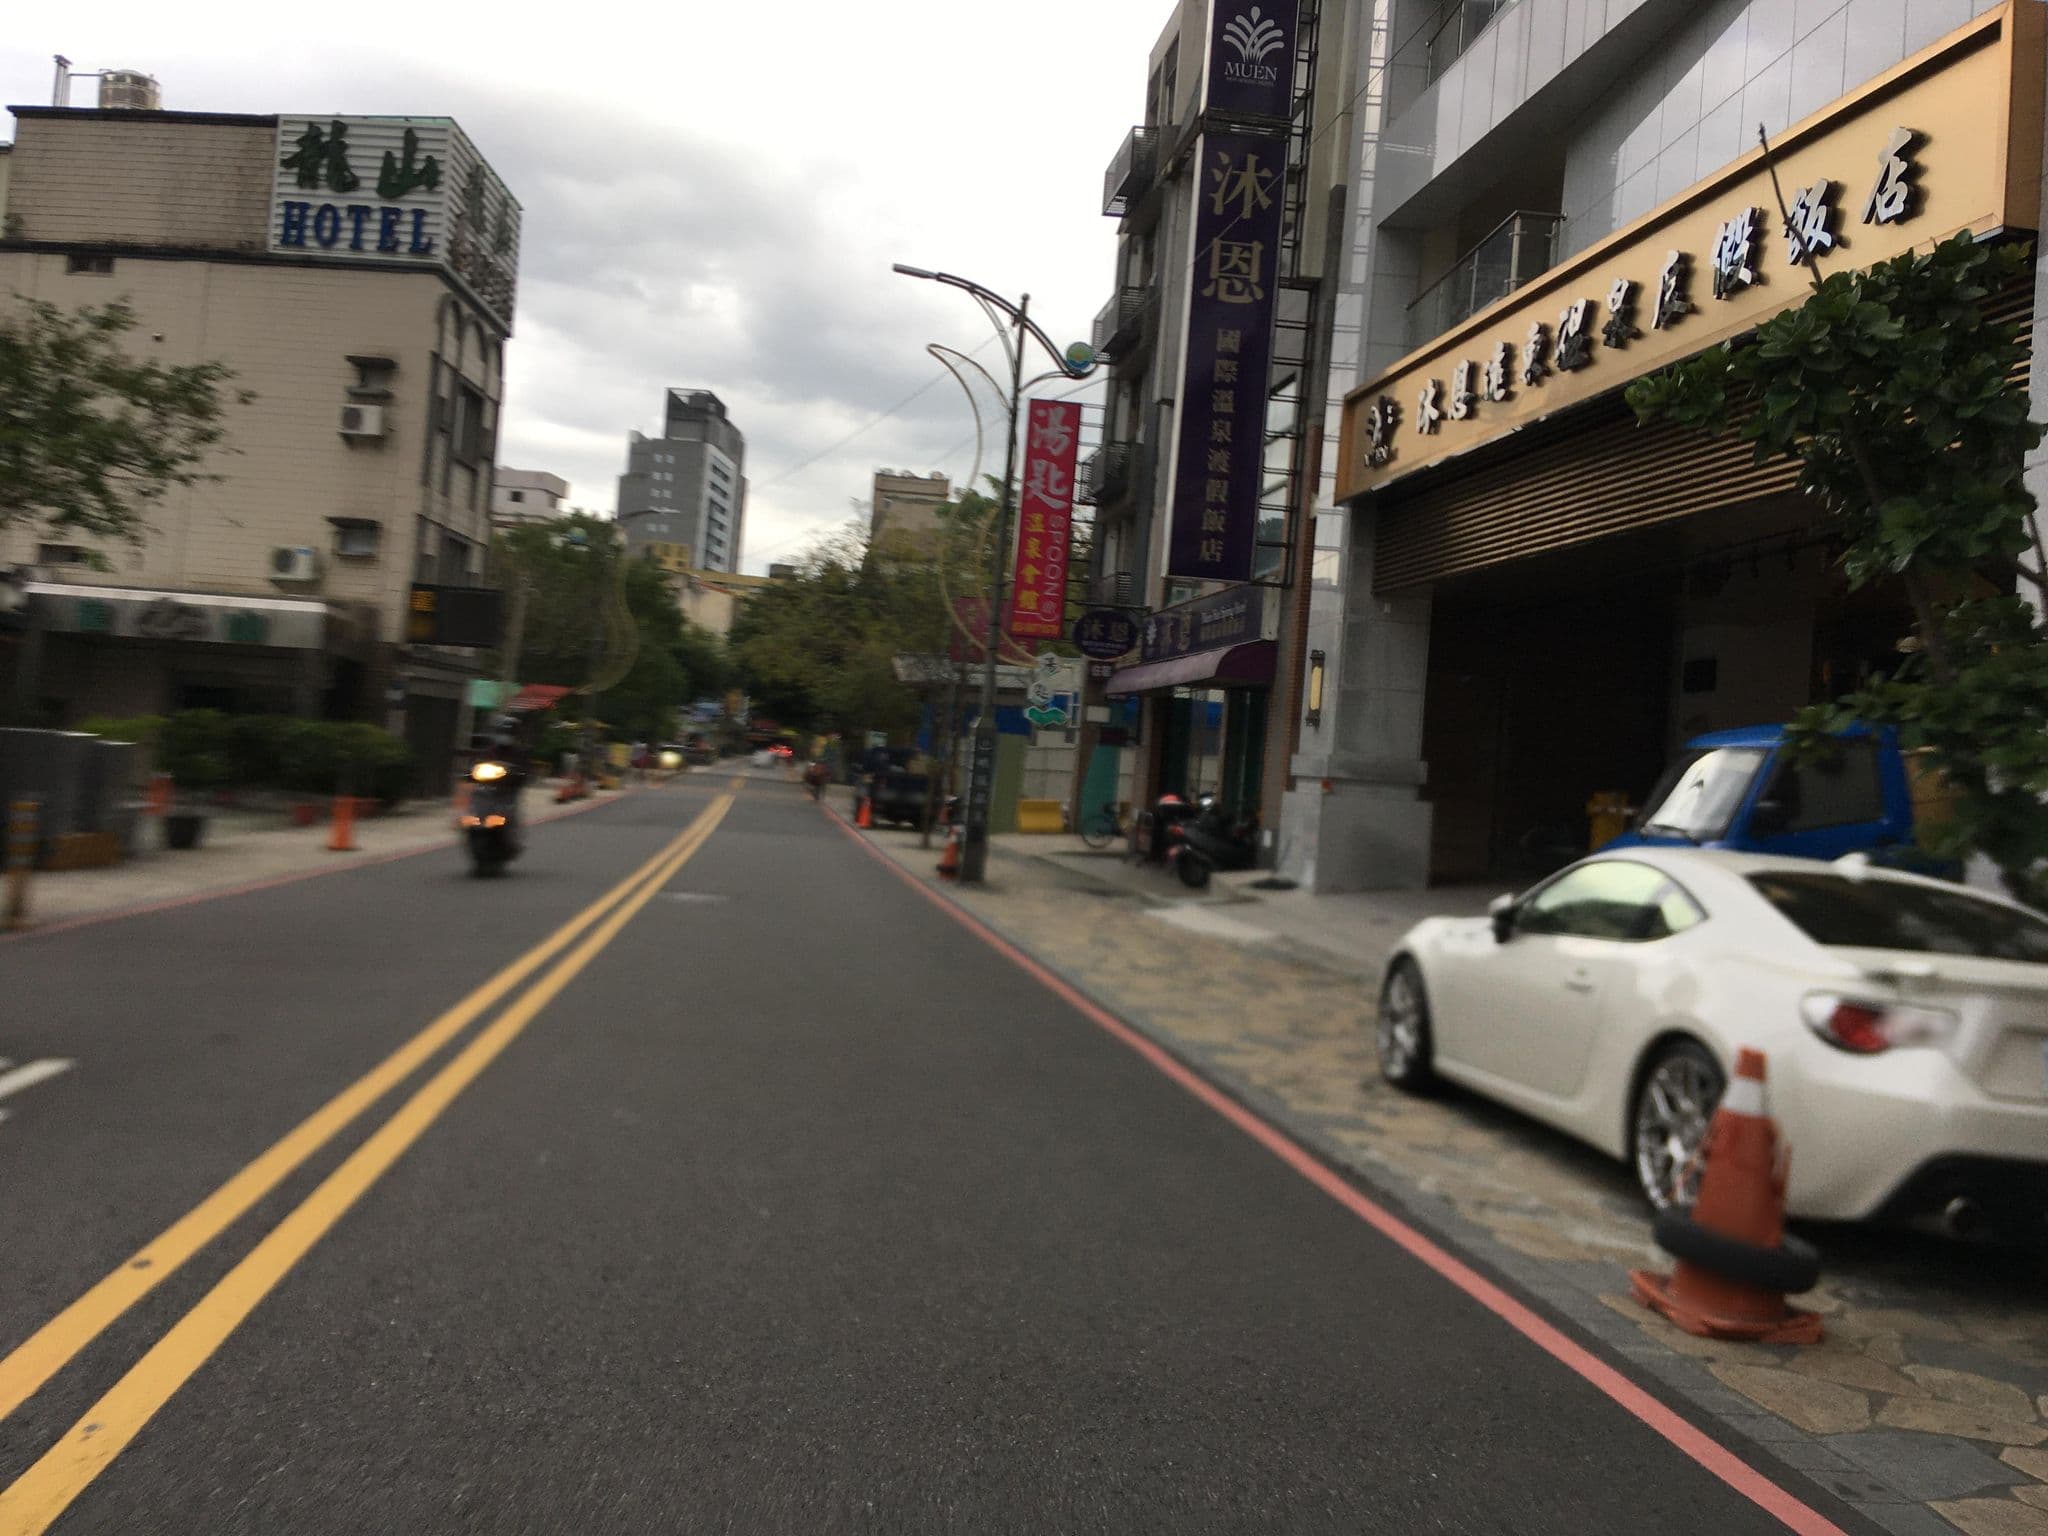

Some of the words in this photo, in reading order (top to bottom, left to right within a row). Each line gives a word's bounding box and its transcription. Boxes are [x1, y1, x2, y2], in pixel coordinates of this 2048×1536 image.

[1224, 62, 1279, 81] MUEN
[280, 120, 442, 199] 龍山
[280, 201, 434, 255] HOTEL
[1201, 151, 1273, 304] 沐恩
